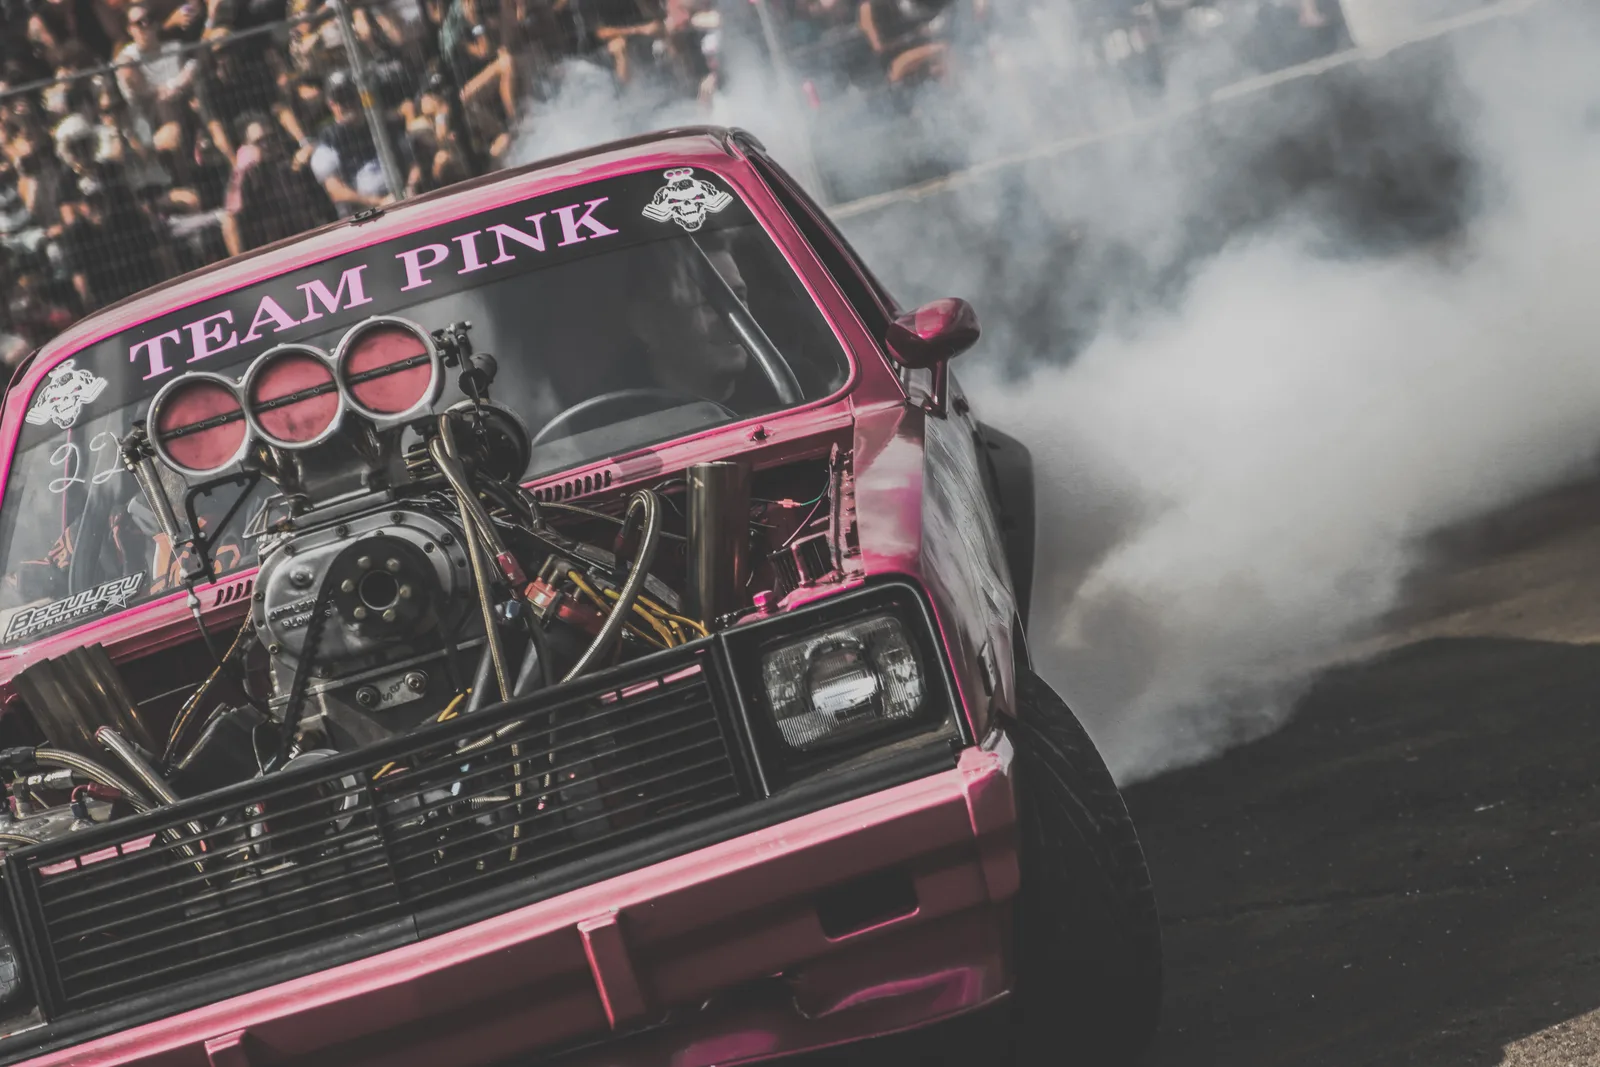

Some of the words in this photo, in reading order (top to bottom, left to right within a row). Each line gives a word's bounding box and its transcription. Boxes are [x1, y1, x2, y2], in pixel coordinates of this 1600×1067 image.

[129, 264, 373, 381] TEAM
[395, 197, 619, 292] PINK
[48, 431, 125, 494] 22
[5, 603, 98, 644] PERFORMANCE
